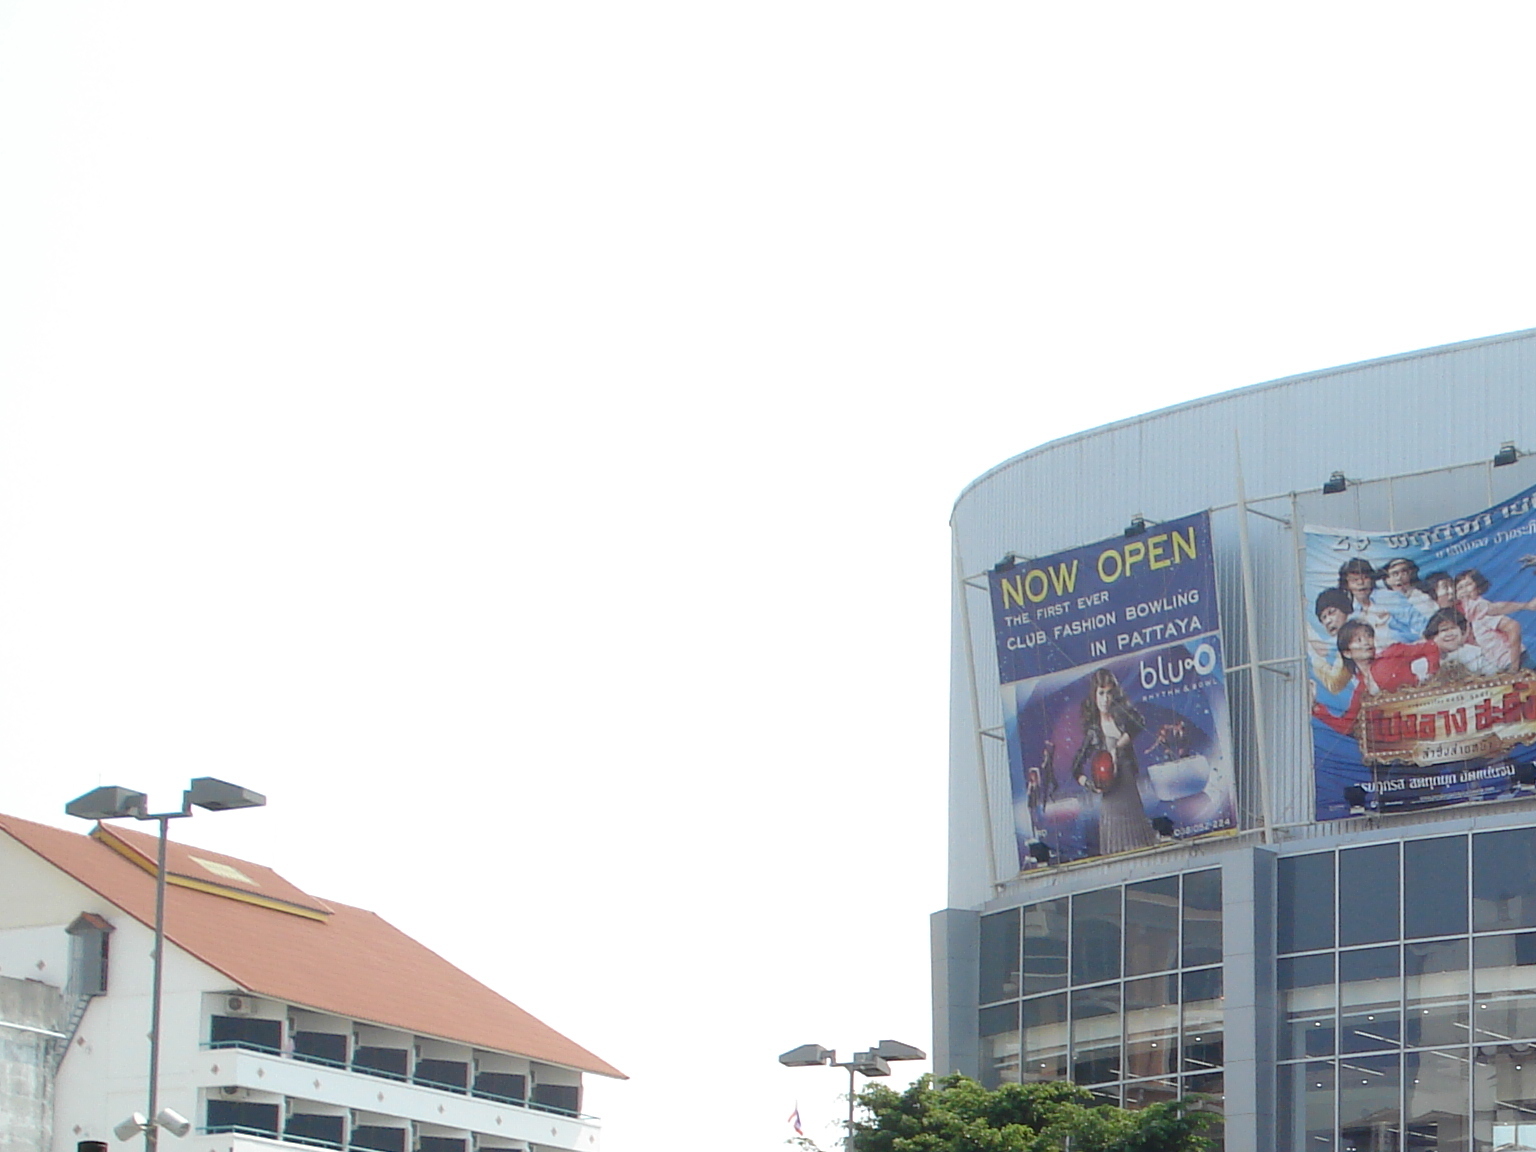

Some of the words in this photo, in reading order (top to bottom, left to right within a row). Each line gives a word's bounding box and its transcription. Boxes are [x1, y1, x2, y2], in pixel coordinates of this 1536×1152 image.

[1001, 560, 1079, 609] NOW
[1097, 526, 1197, 583] OPEN
[1004, 611, 1030, 627] THE
[1036, 600, 1070, 621] FIRST
[1077, 590, 1110, 612] EVER
[1006, 631, 1047, 651] CLUB
[1054, 612, 1116, 638] FASHION
[1125, 590, 1199, 621] BOWLING
[1090, 640, 1107, 658] IN
[1117, 615, 1202, 652] PATTAYA
[1192, 678, 1218, 690] BOWL
